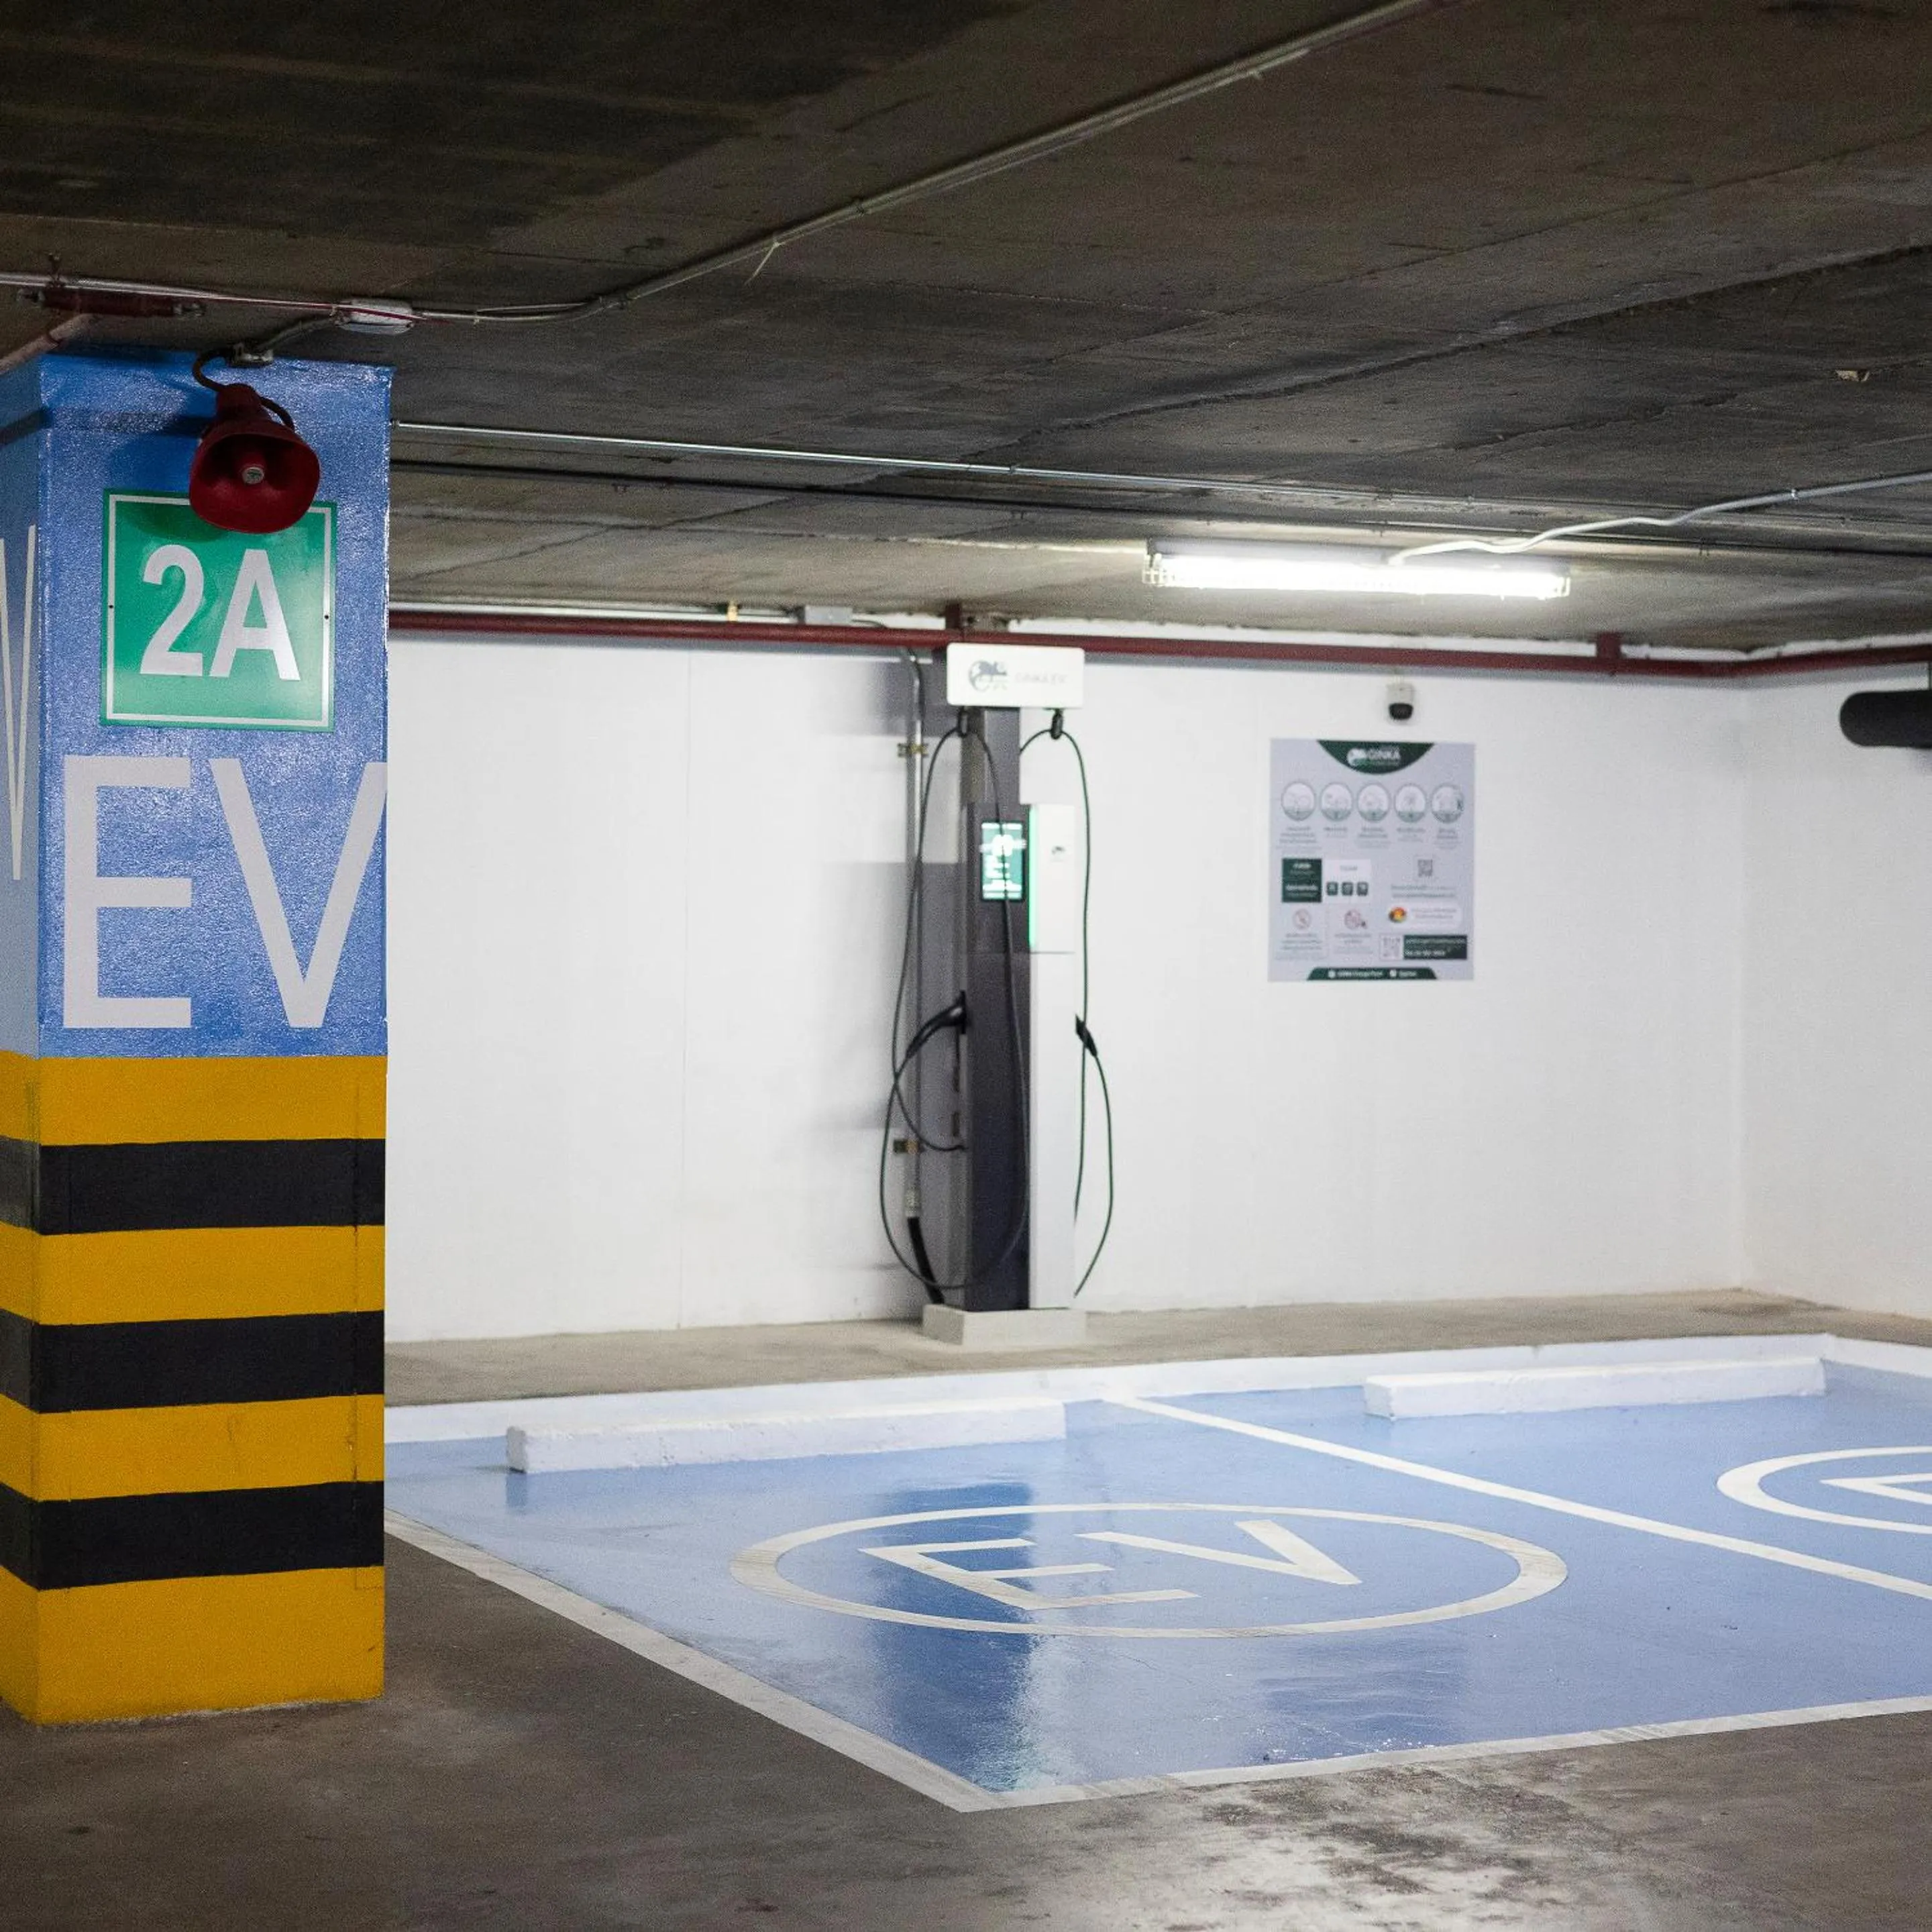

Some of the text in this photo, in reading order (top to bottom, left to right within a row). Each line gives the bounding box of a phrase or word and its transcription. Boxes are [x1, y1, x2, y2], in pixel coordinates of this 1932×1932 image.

[140, 543, 301, 681] 2A
[62, 755, 387, 1028] EV
[859, 1519, 1362, 1610] EV
